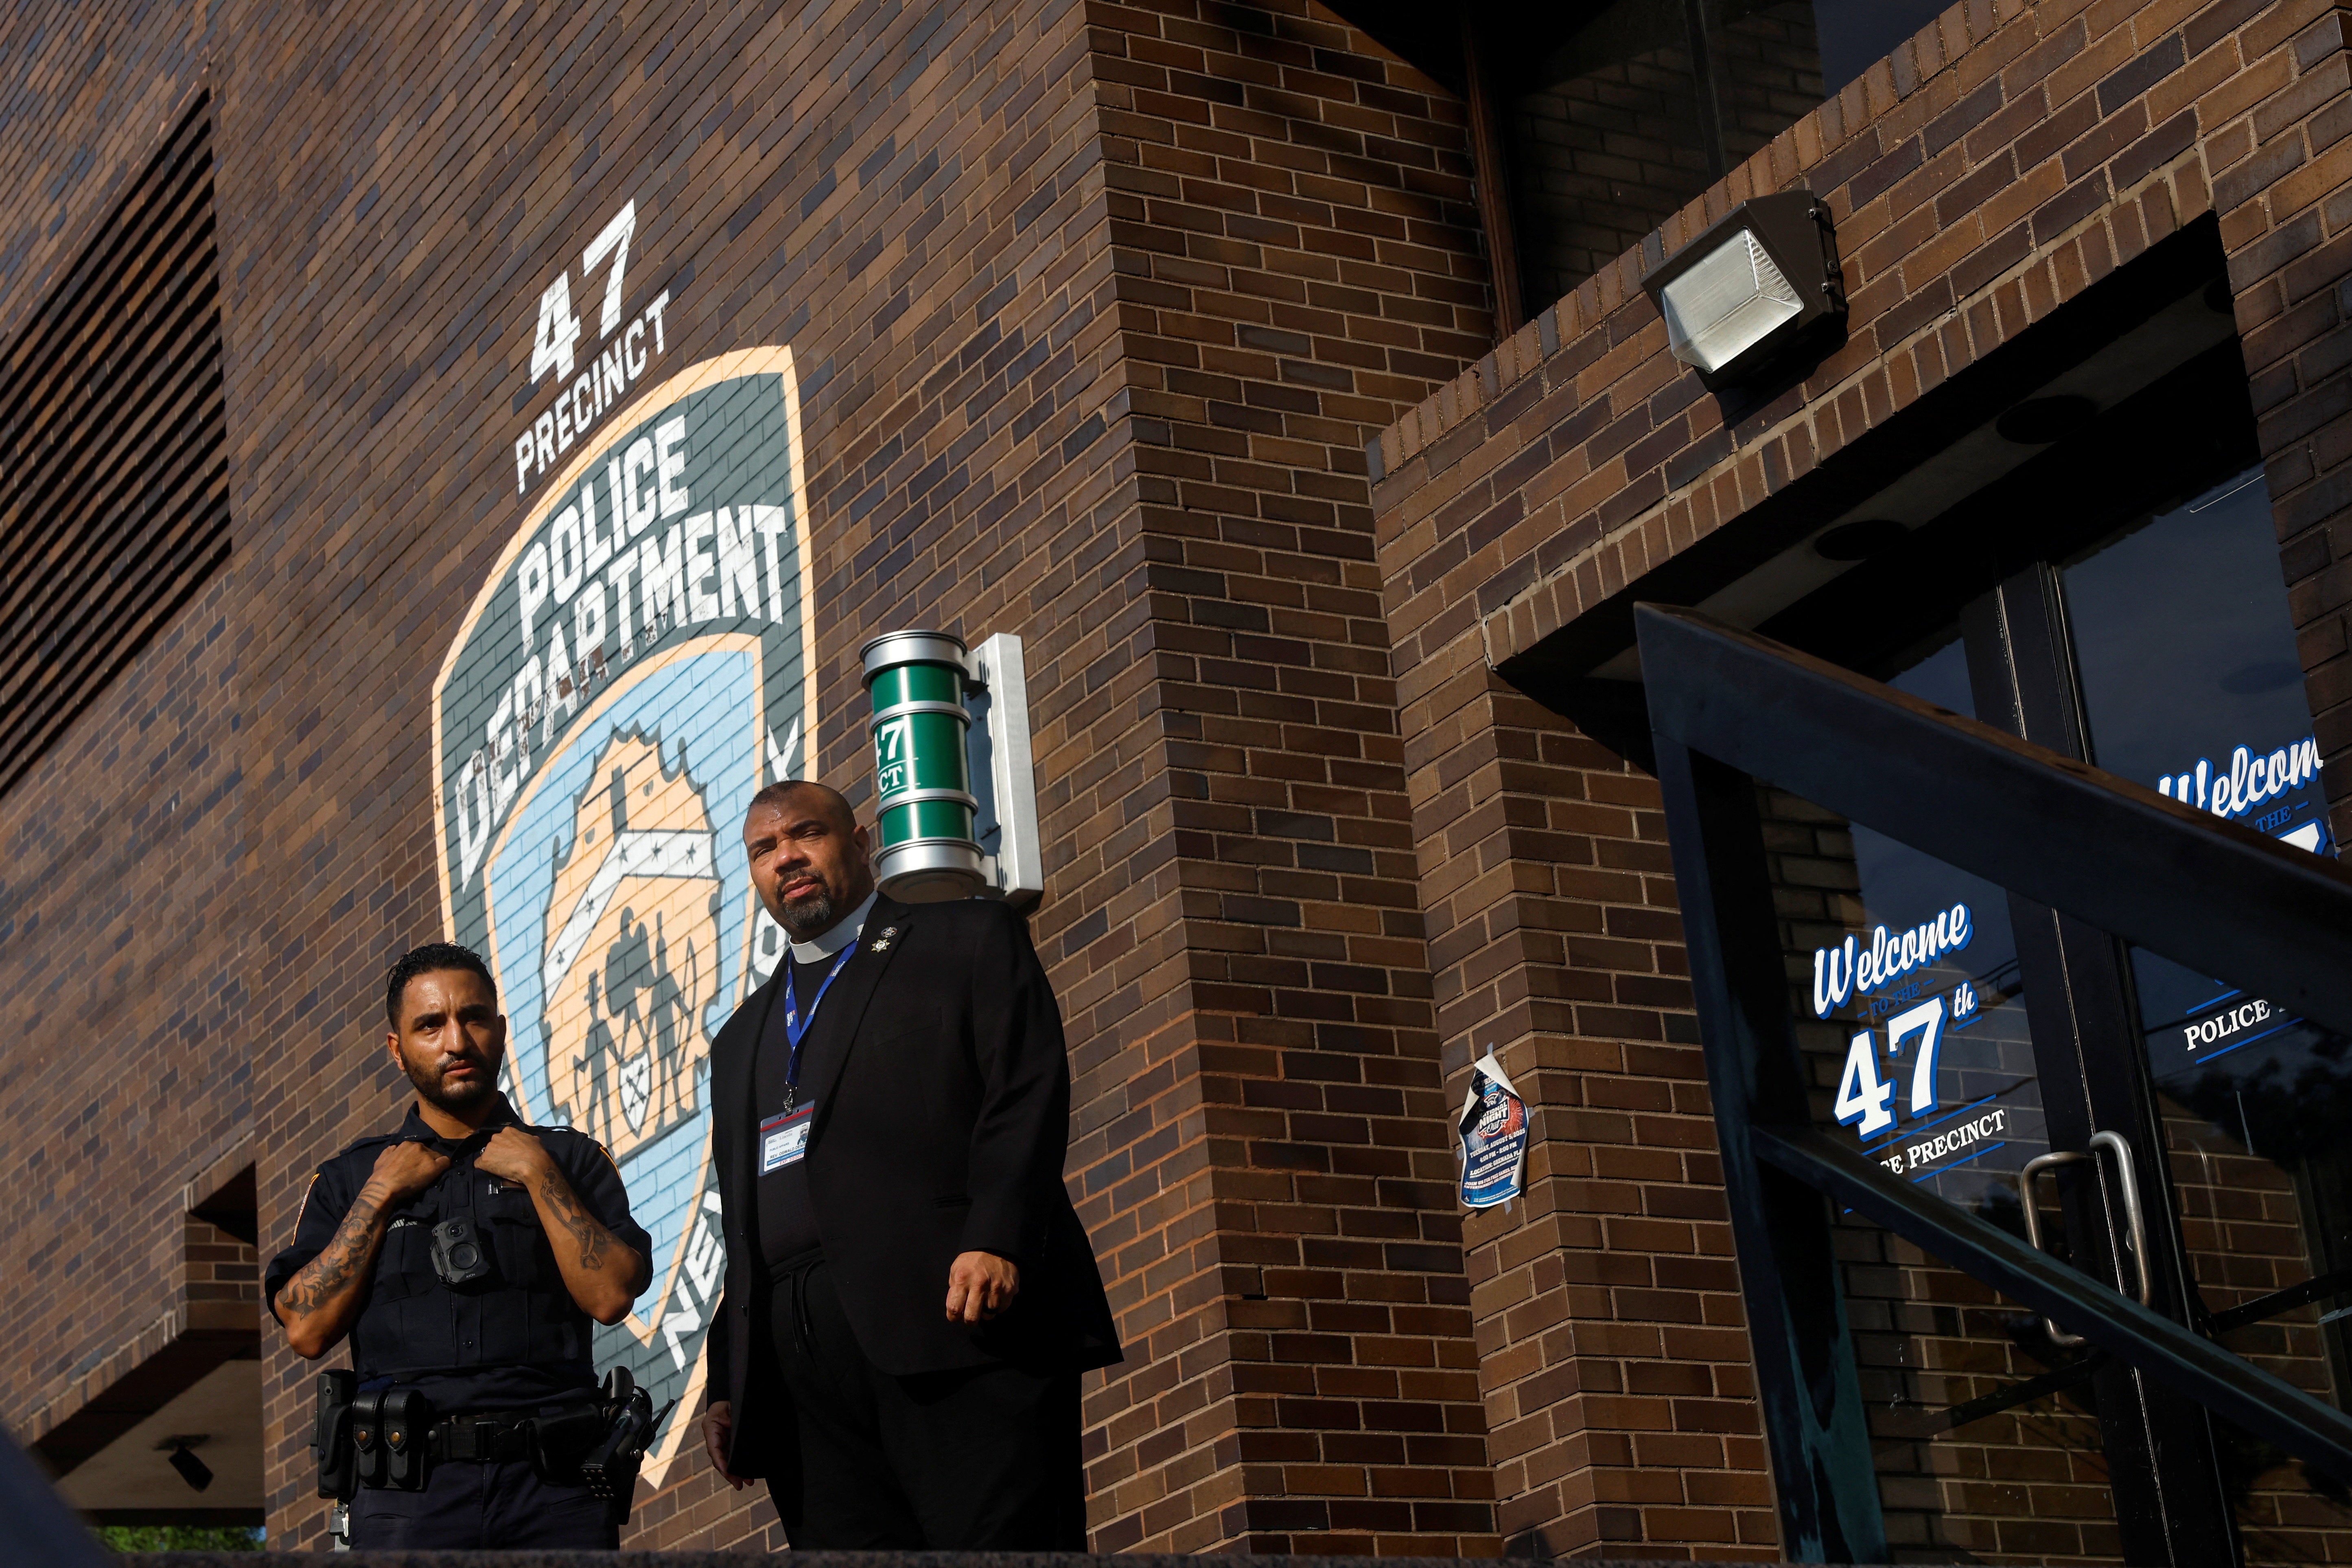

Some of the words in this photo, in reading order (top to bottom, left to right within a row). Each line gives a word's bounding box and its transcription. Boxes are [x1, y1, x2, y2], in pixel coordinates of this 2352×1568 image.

[531, 198, 636, 384] 47
[515, 289, 669, 494] PRECINCT
[517, 414, 688, 657] POLICE
[455, 505, 786, 894] DEPARTMENT
[877, 765, 903, 793] CT
[2158, 736, 2324, 818] Welcom
[2255, 805, 2291, 833] THE
[1814, 902, 1971, 1017] Welcome
[1869, 997, 1889, 1016] TO
[1892, 981, 1921, 1006] THE
[2184, 999, 2270, 1051] POLICE
[1479, 1101, 1508, 1118] NATIONAL
[1479, 1107, 1507, 1130] NIGHT
[1486, 1120, 1501, 1133] Out
[1907, 1109, 2004, 1169] PRECINCT
[779, 1147, 794, 1156] OSWALD
[1470, 1144, 1490, 1158] TUESDAY,
[1490, 1136, 1508, 1148] AUGUST
[1513, 1128, 1525, 1137] 2025
[1509, 1141, 1517, 1149] PM
[1469, 1162, 1493, 1176] LOCATION:
